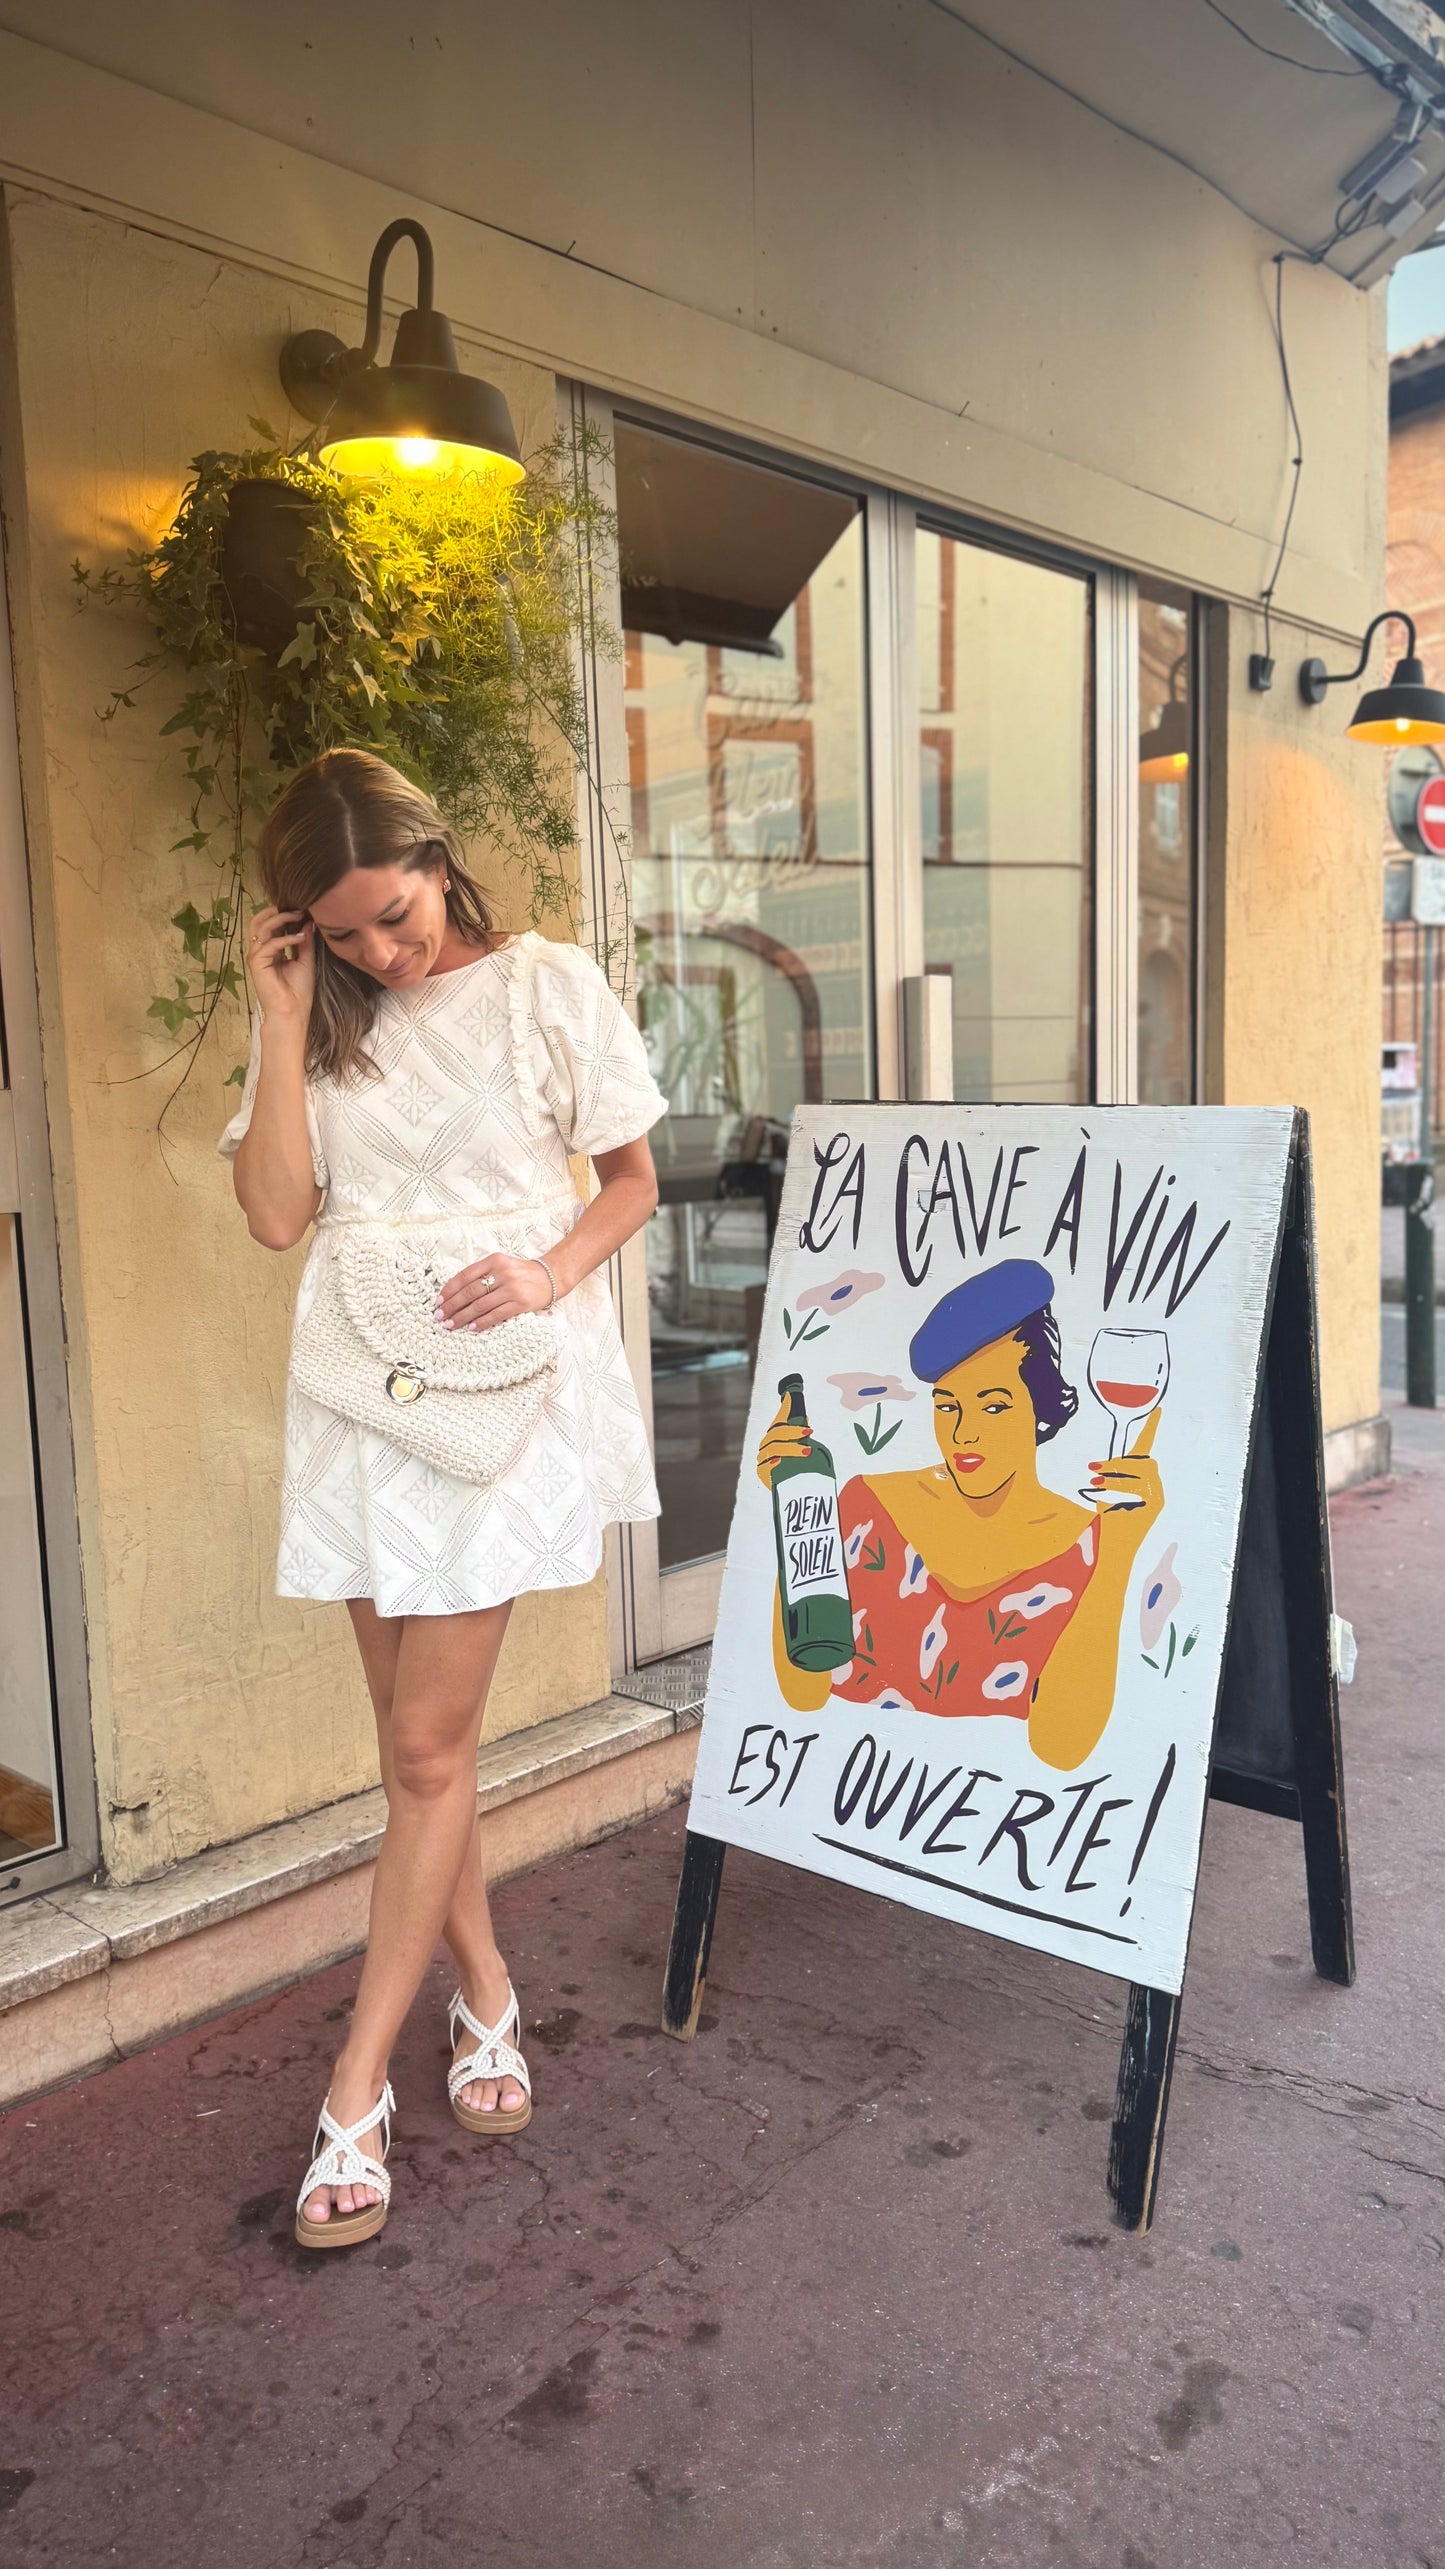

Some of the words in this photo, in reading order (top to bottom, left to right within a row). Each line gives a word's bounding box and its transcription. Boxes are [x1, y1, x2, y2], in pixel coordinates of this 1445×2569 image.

[799, 1132, 865, 1254] LA
[895, 1134, 1041, 1287] CAVE
[1043, 1127, 1092, 1276] À
[727, 1723, 820, 1808] EST
